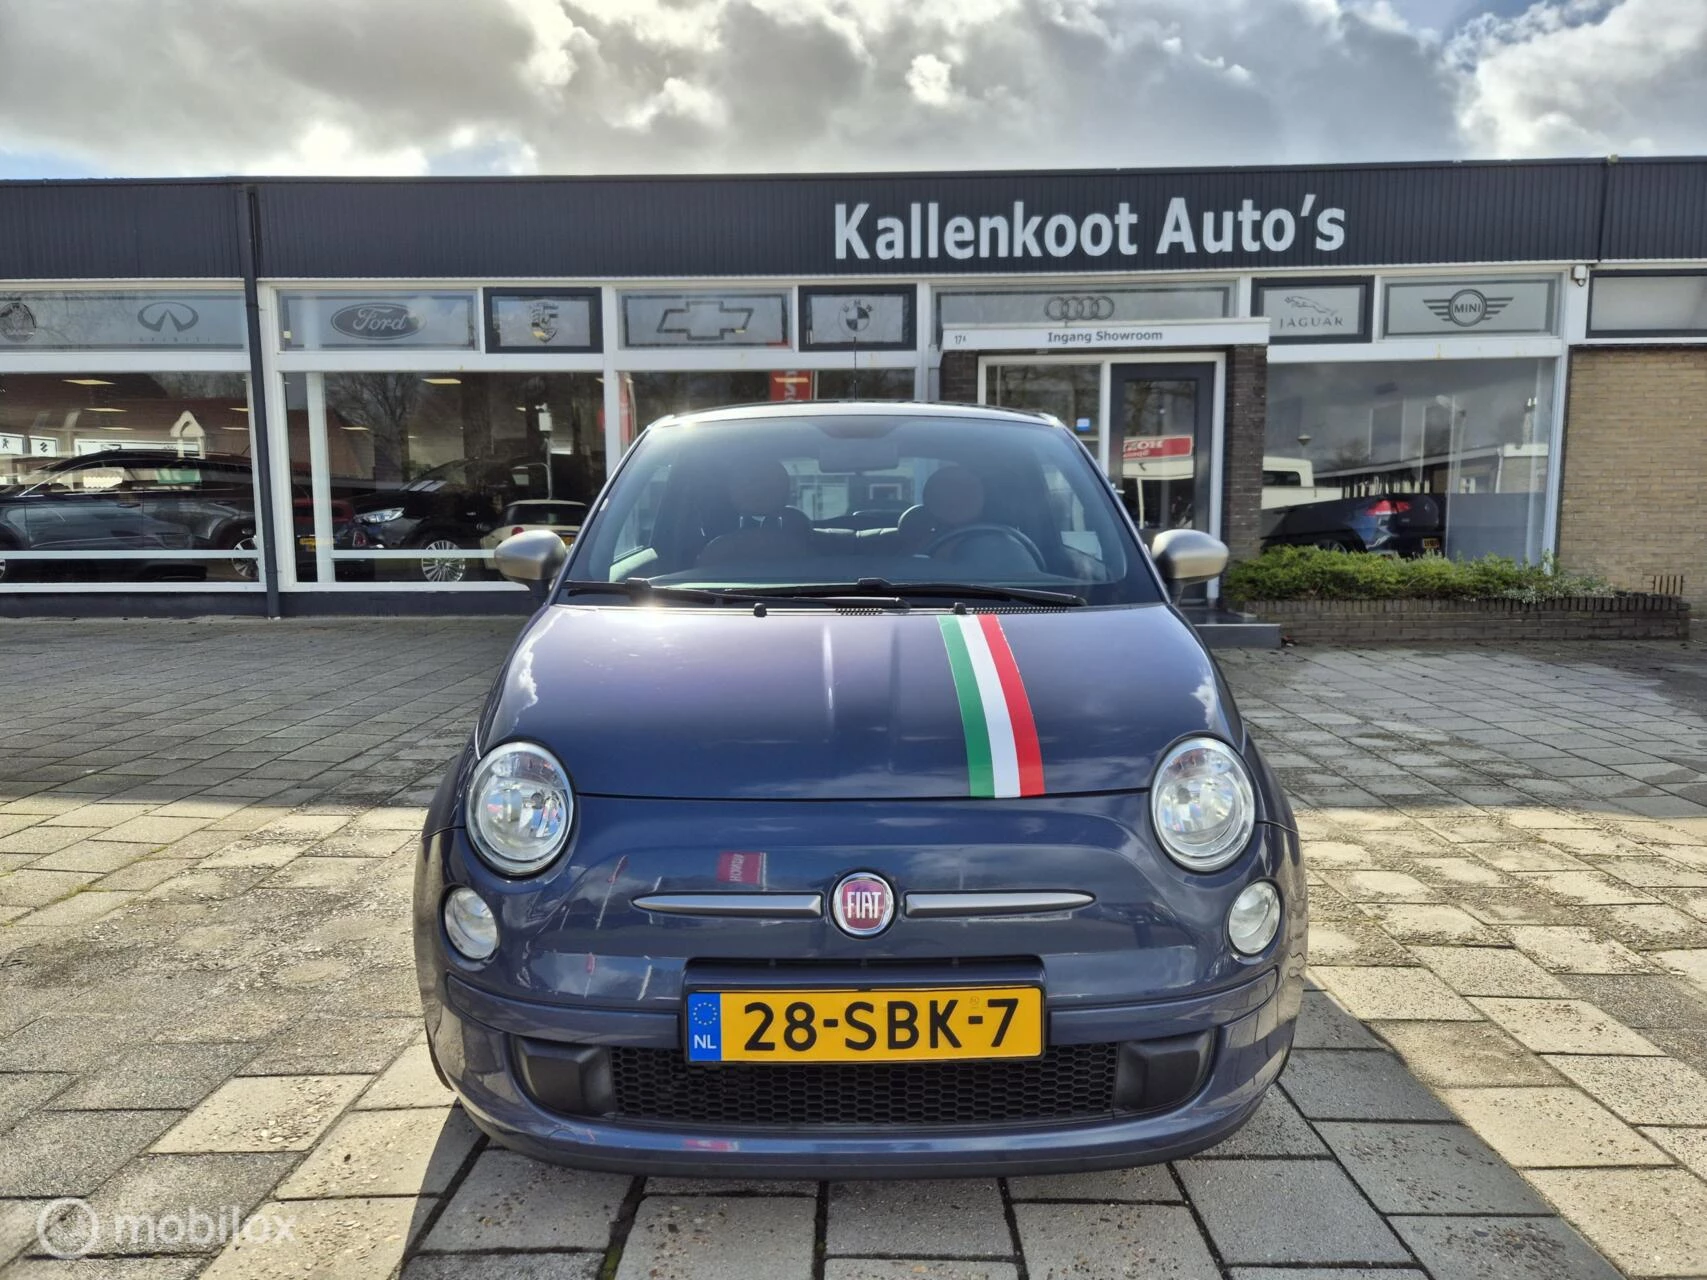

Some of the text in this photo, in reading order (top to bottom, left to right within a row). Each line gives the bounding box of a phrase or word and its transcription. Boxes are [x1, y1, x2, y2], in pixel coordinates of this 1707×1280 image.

[834, 193, 1346, 260] Kallenkoot Auto's
[1453, 302, 1482, 314] MINI
[352, 306, 409, 331] Ford
[1279, 316, 1344, 329] JAGUAR
[1047, 330, 1163, 345] Ingang Showroom
[847, 891, 882, 919] FIAT
[743, 998, 1020, 1052] 28-SBK-7
[693, 1034, 717, 1050] NL
